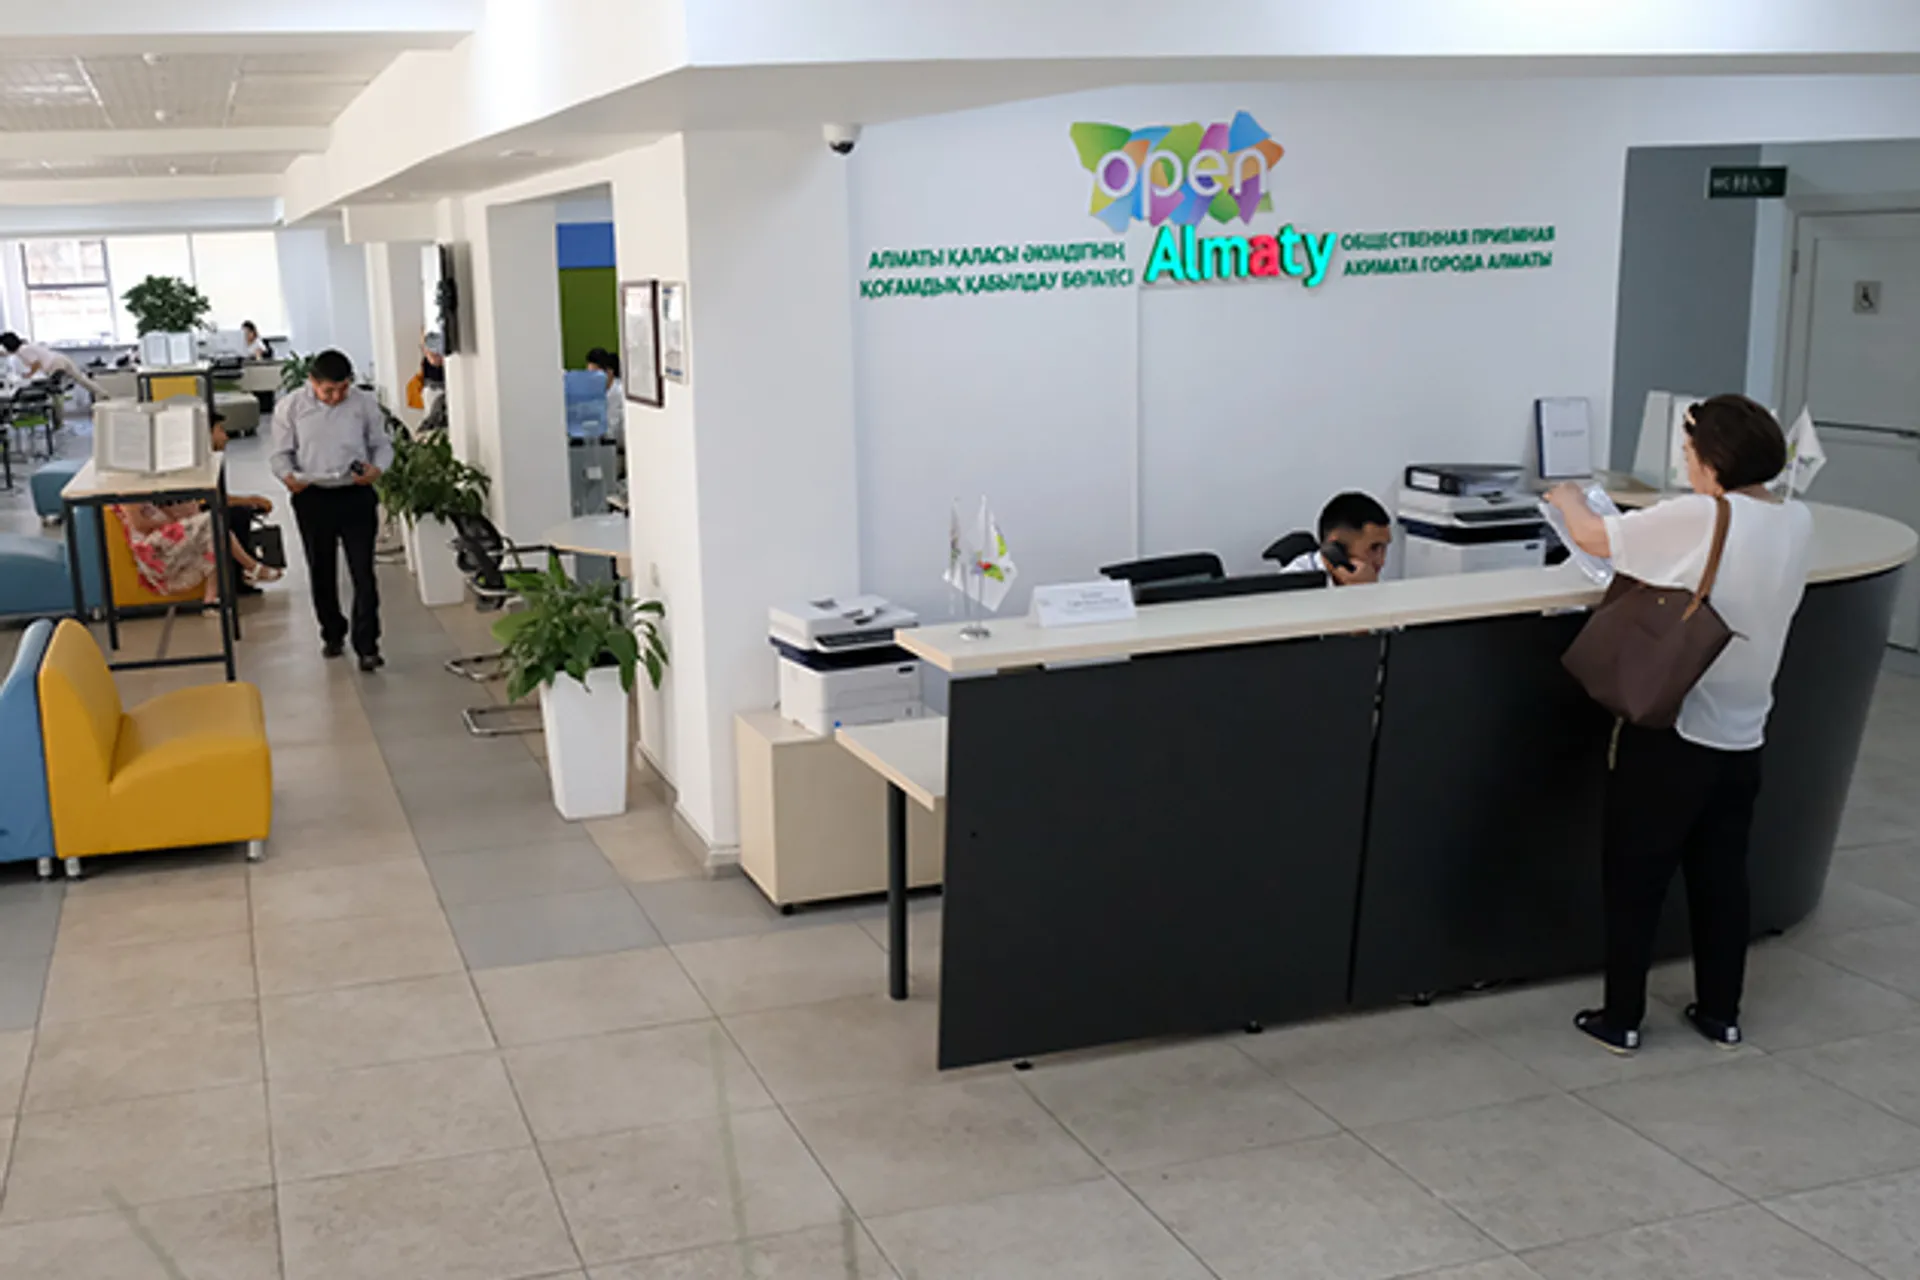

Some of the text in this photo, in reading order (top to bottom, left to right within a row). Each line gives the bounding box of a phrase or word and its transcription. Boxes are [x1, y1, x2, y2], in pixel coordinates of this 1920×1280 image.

[1096, 149, 1267, 220] open
[1341, 226, 1555, 250] ОБЩЕСТВЕННАЯ ПРИЕМНАЯ
[869, 248, 943, 269] АЛМАТЫ
[1143, 223, 1337, 288] Almaty
[1343, 250, 1552, 276] АКИМАТА ГОРОДА АЛМАТЫ
